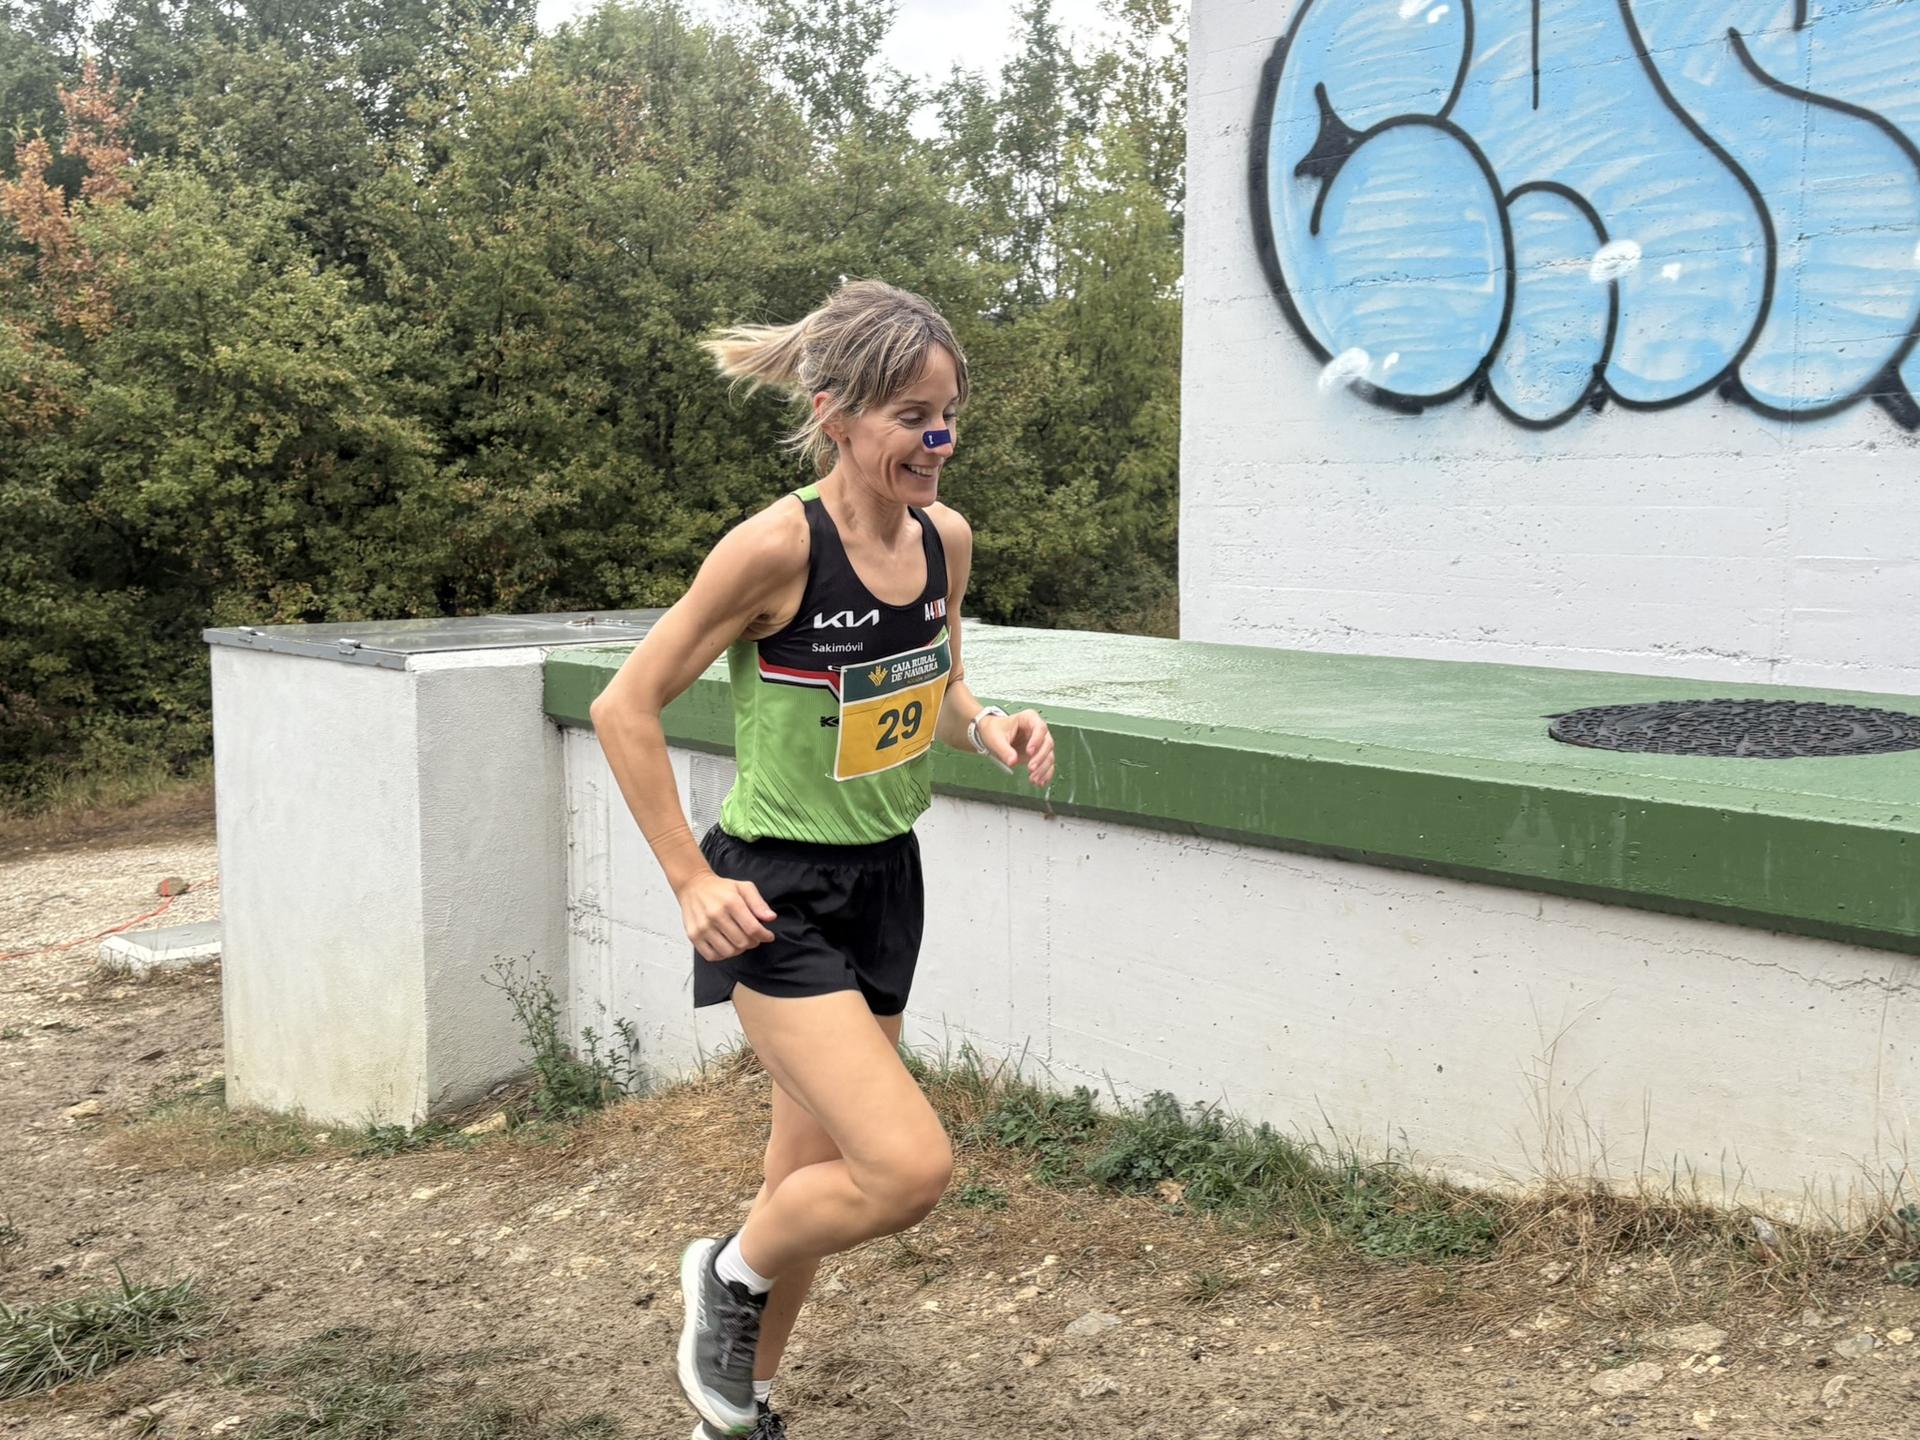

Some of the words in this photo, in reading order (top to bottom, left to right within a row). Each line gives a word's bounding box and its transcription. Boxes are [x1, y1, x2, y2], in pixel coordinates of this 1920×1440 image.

[813, 609, 880, 629] KIA
[811, 641, 864, 653] Sakimóvil
[891, 660, 911, 674] CAJA
[911, 653, 937, 668] RURAL
[891, 672, 903, 683] DE
[904, 661, 938, 679] NAVARRA
[875, 701, 923, 751] 29
